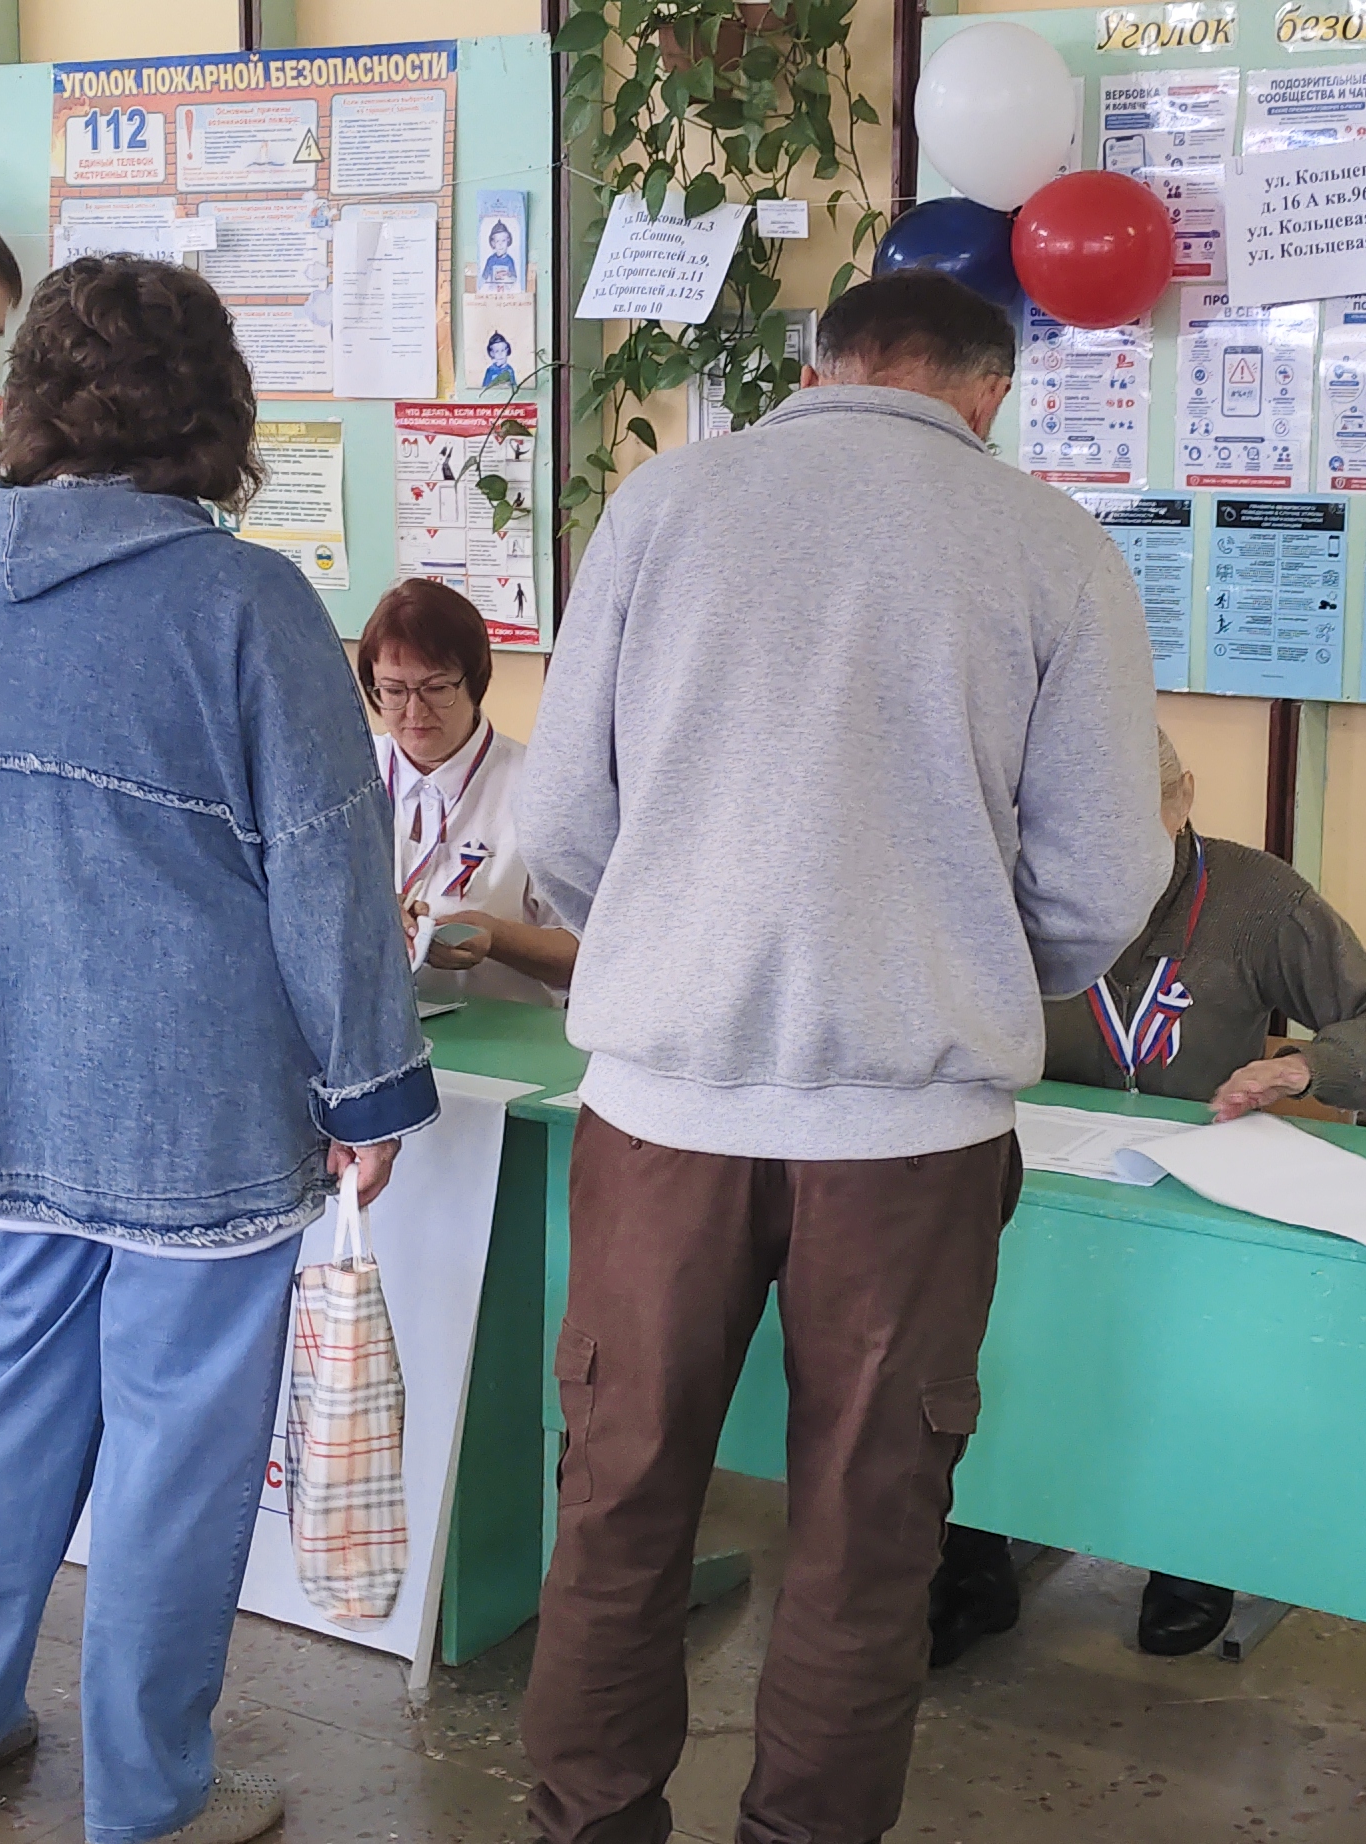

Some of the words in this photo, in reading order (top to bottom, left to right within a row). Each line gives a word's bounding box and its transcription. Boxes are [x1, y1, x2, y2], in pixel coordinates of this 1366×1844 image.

[1096, 13, 1236, 50] Уголок
[62, 68, 136, 99] УГОЛОК
[142, 54, 265, 96] ПОЖАРНОЙ
[270, 52, 449, 88] БЕЗОПАСНОСТИ
[1105, 87, 1161, 101] ВЕРБОВКА
[1258, 91, 1335, 104] СООБЩЕСТВА
[1338, 88, 1346, 99] И
[84, 107, 149, 152] 112
[79, 157, 114, 169] ЕДИНЫЙ
[116, 157, 154, 168] ТЕЛЕФОН
[73, 169, 129, 181] ЭКСТРЕННЫХ
[131, 168, 159, 179] СЛУЖБ
[1264, 176, 1290, 193] ул.
[1261, 201, 1277, 215] д.
[1282, 194, 1301, 211] 16
[1305, 193, 1319, 209] А
[1246, 226, 1273, 242] ул.
[622, 247, 686, 262] Строителей
[1248, 249, 1275, 266] ул.
[616, 265, 676, 281] Строителей
[609, 284, 665, 297] Строителей
[666, 287, 706, 301] д.12/5
[650, 301, 663, 313] 10
